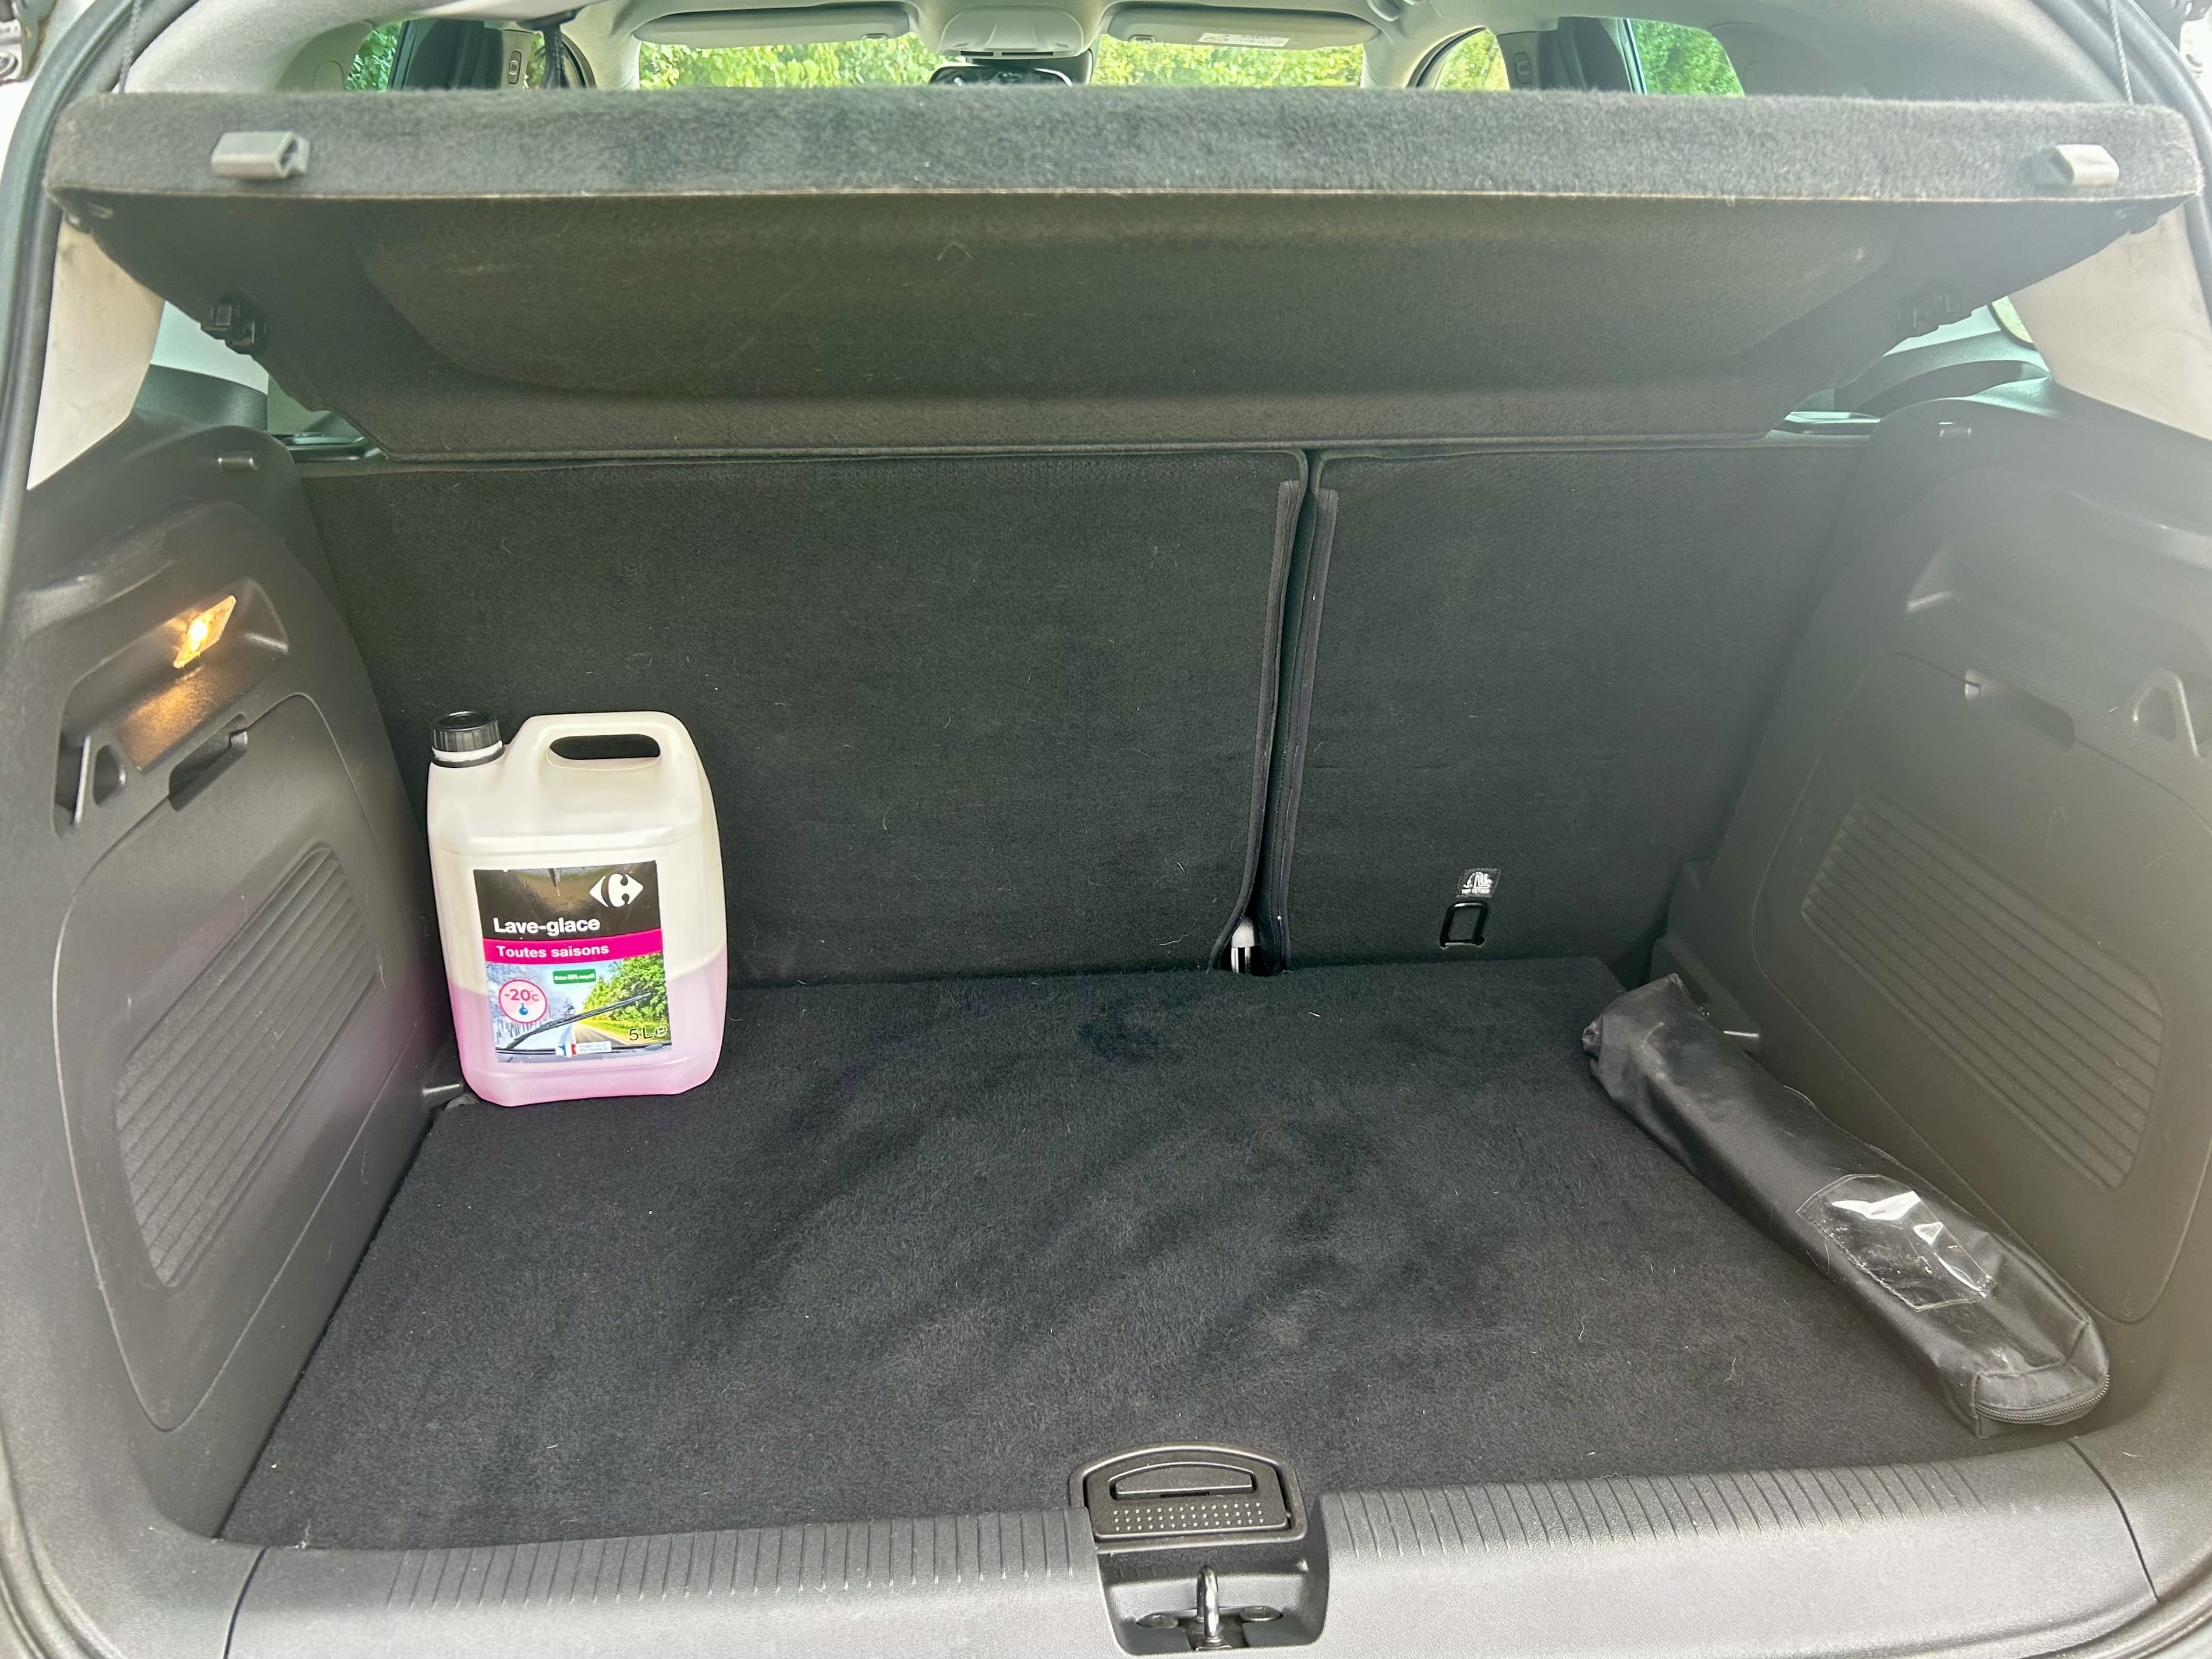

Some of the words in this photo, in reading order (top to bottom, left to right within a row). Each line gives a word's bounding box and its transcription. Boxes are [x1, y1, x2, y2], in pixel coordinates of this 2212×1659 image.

[493, 917, 600, 936] Lave-glace
[496, 945, 547, 958] Toutes
[551, 945, 609, 958] saisons
